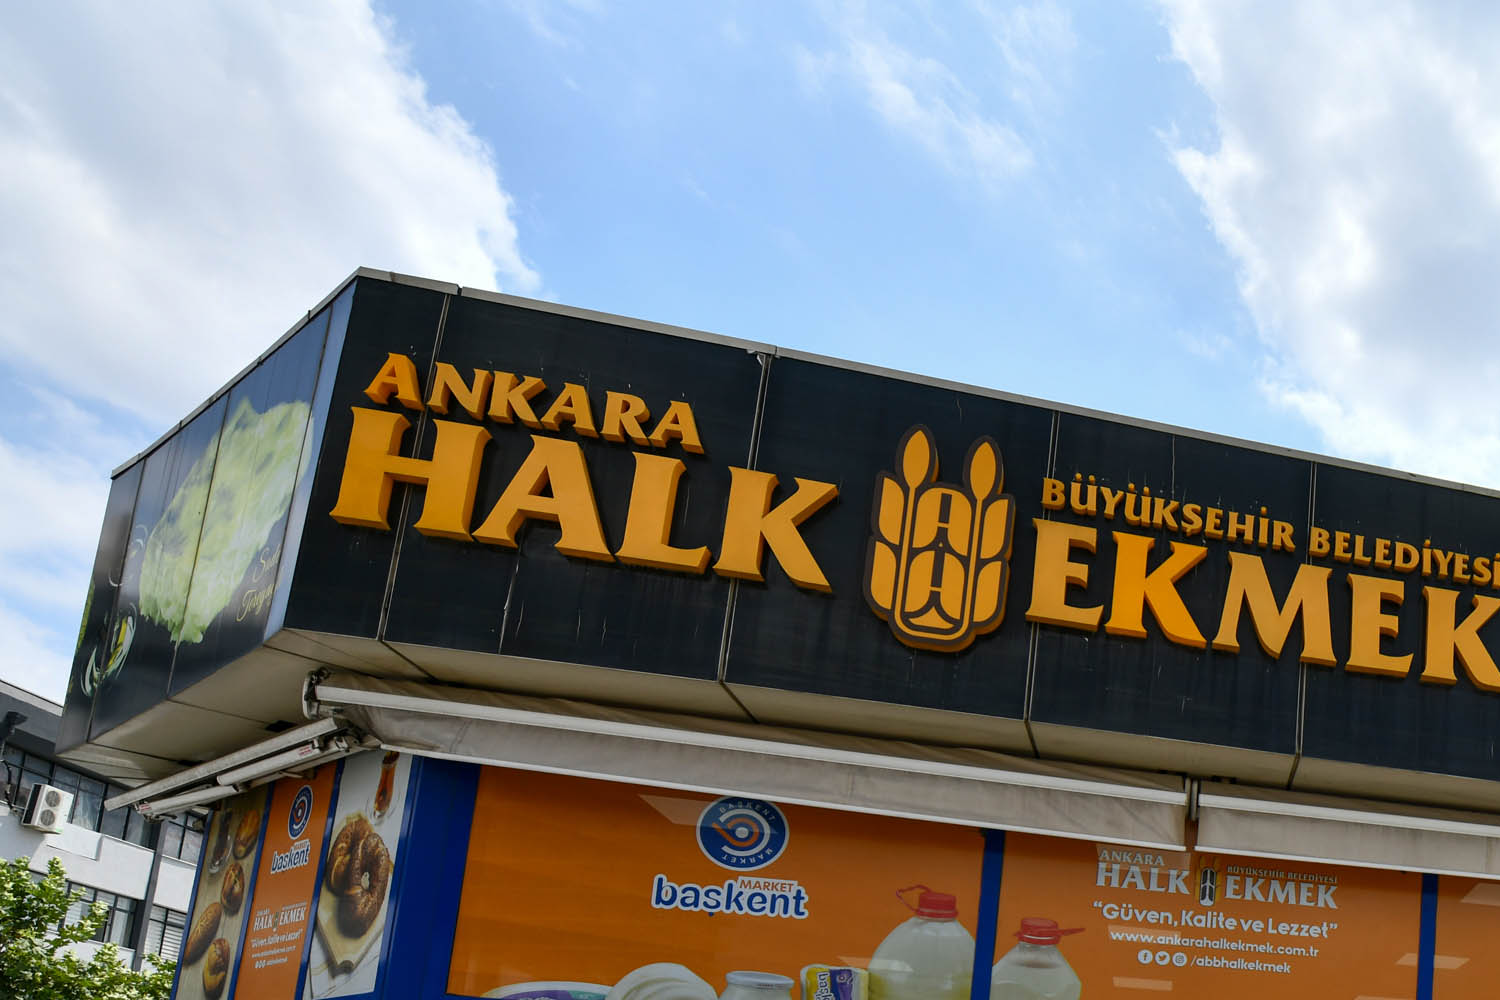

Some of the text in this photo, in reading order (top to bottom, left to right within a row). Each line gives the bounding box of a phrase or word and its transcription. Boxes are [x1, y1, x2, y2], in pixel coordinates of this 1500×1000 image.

[364, 352, 705, 455] ANKARA
[1042, 472, 1296, 552] BÜYÜKŞEHİR
[329, 406, 839, 593] HALK
[1100, 850, 1165, 867] ANKARA
[653, 875, 807, 917] başkent
[739, 879, 795, 893] MARKET
[1096, 863, 1338, 909] HALK EKMEK
[1181, 909, 1238, 930] Kalite
[1240, 917, 1264, 932] ve
[1110, 930, 1319, 957] www.ankarahalkekmek.com.tr
